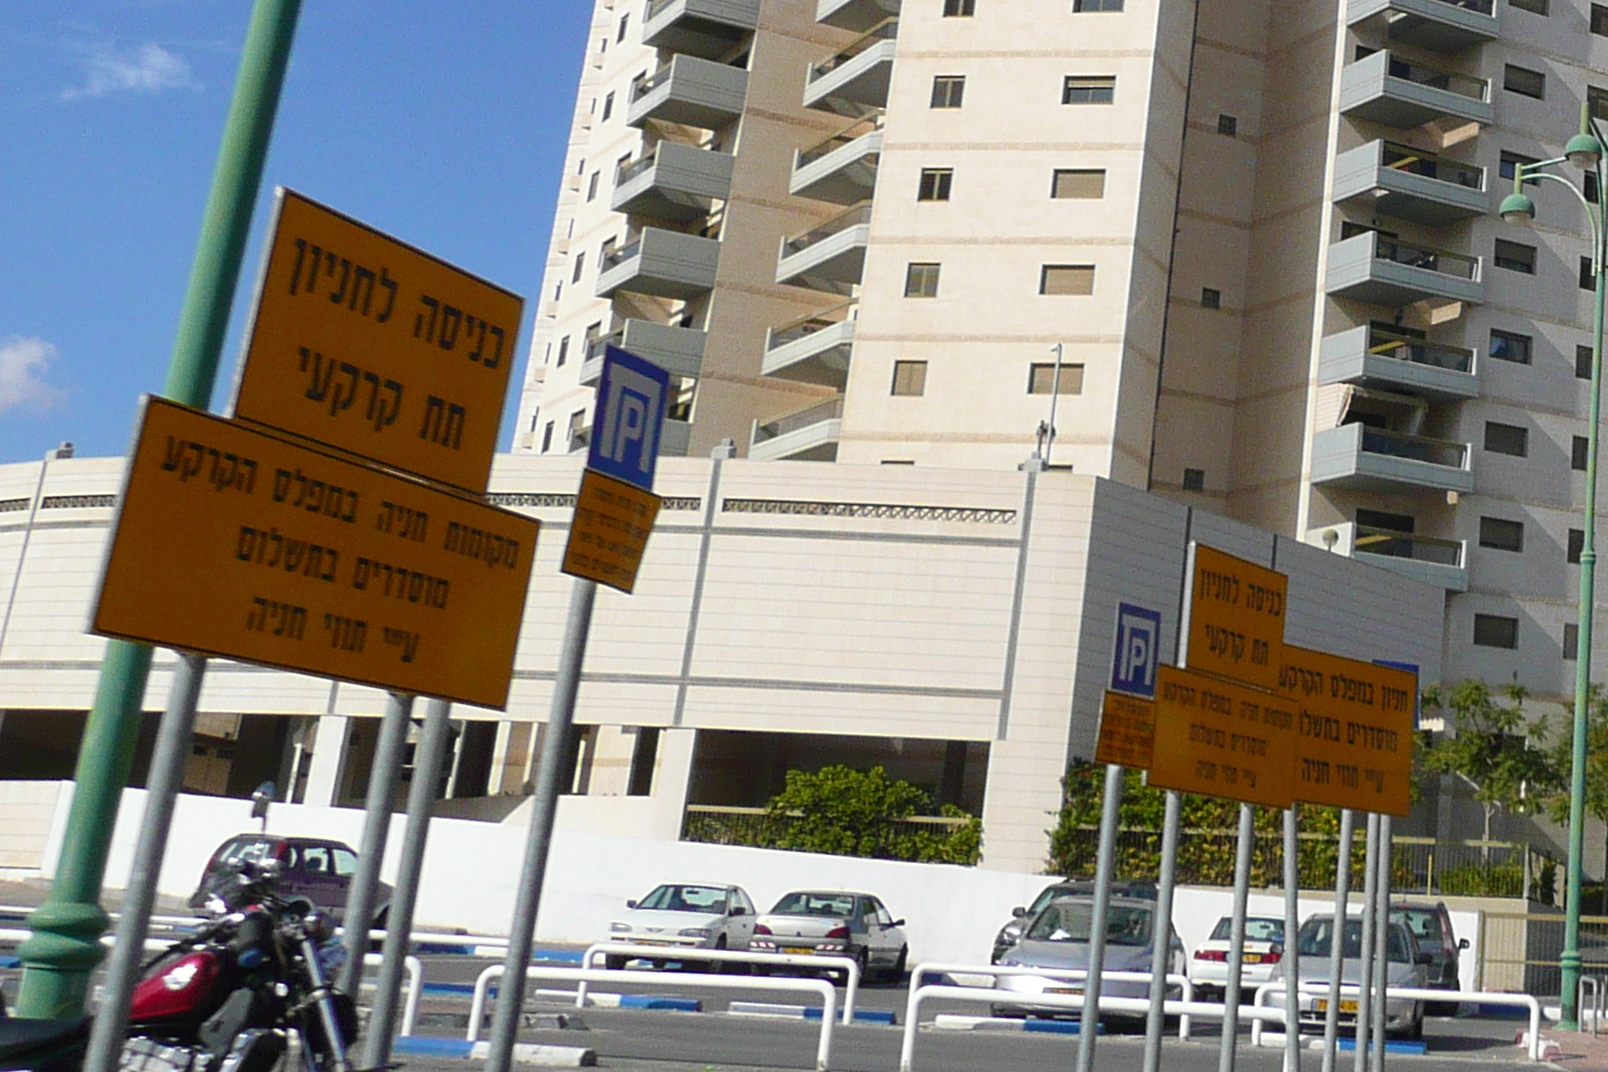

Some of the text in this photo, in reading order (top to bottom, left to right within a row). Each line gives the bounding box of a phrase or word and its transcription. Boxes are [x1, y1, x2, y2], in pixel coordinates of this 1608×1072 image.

[288, 236, 505, 370] כניסה לחניון
[298, 345, 405, 432] קרקעי
[160, 433, 259, 495] הקרקע
[271, 466, 360, 524] במפלס
[375, 499, 430, 543] חניה
[442, 520, 520, 569] מקומות
[235, 525, 450, 610] מוסדרים בתשלום
[1199, 568, 1283, 617] כניסה לחניון
[245, 595, 308, 642] חניה
[1204, 622, 1246, 664] קרקעי
[1278, 664, 1324, 697] הקרקע
[1330, 672, 1375, 705] במפלס
[1299, 708, 1341, 742] בתשלו
[1301, 756, 1331, 785] חניה
